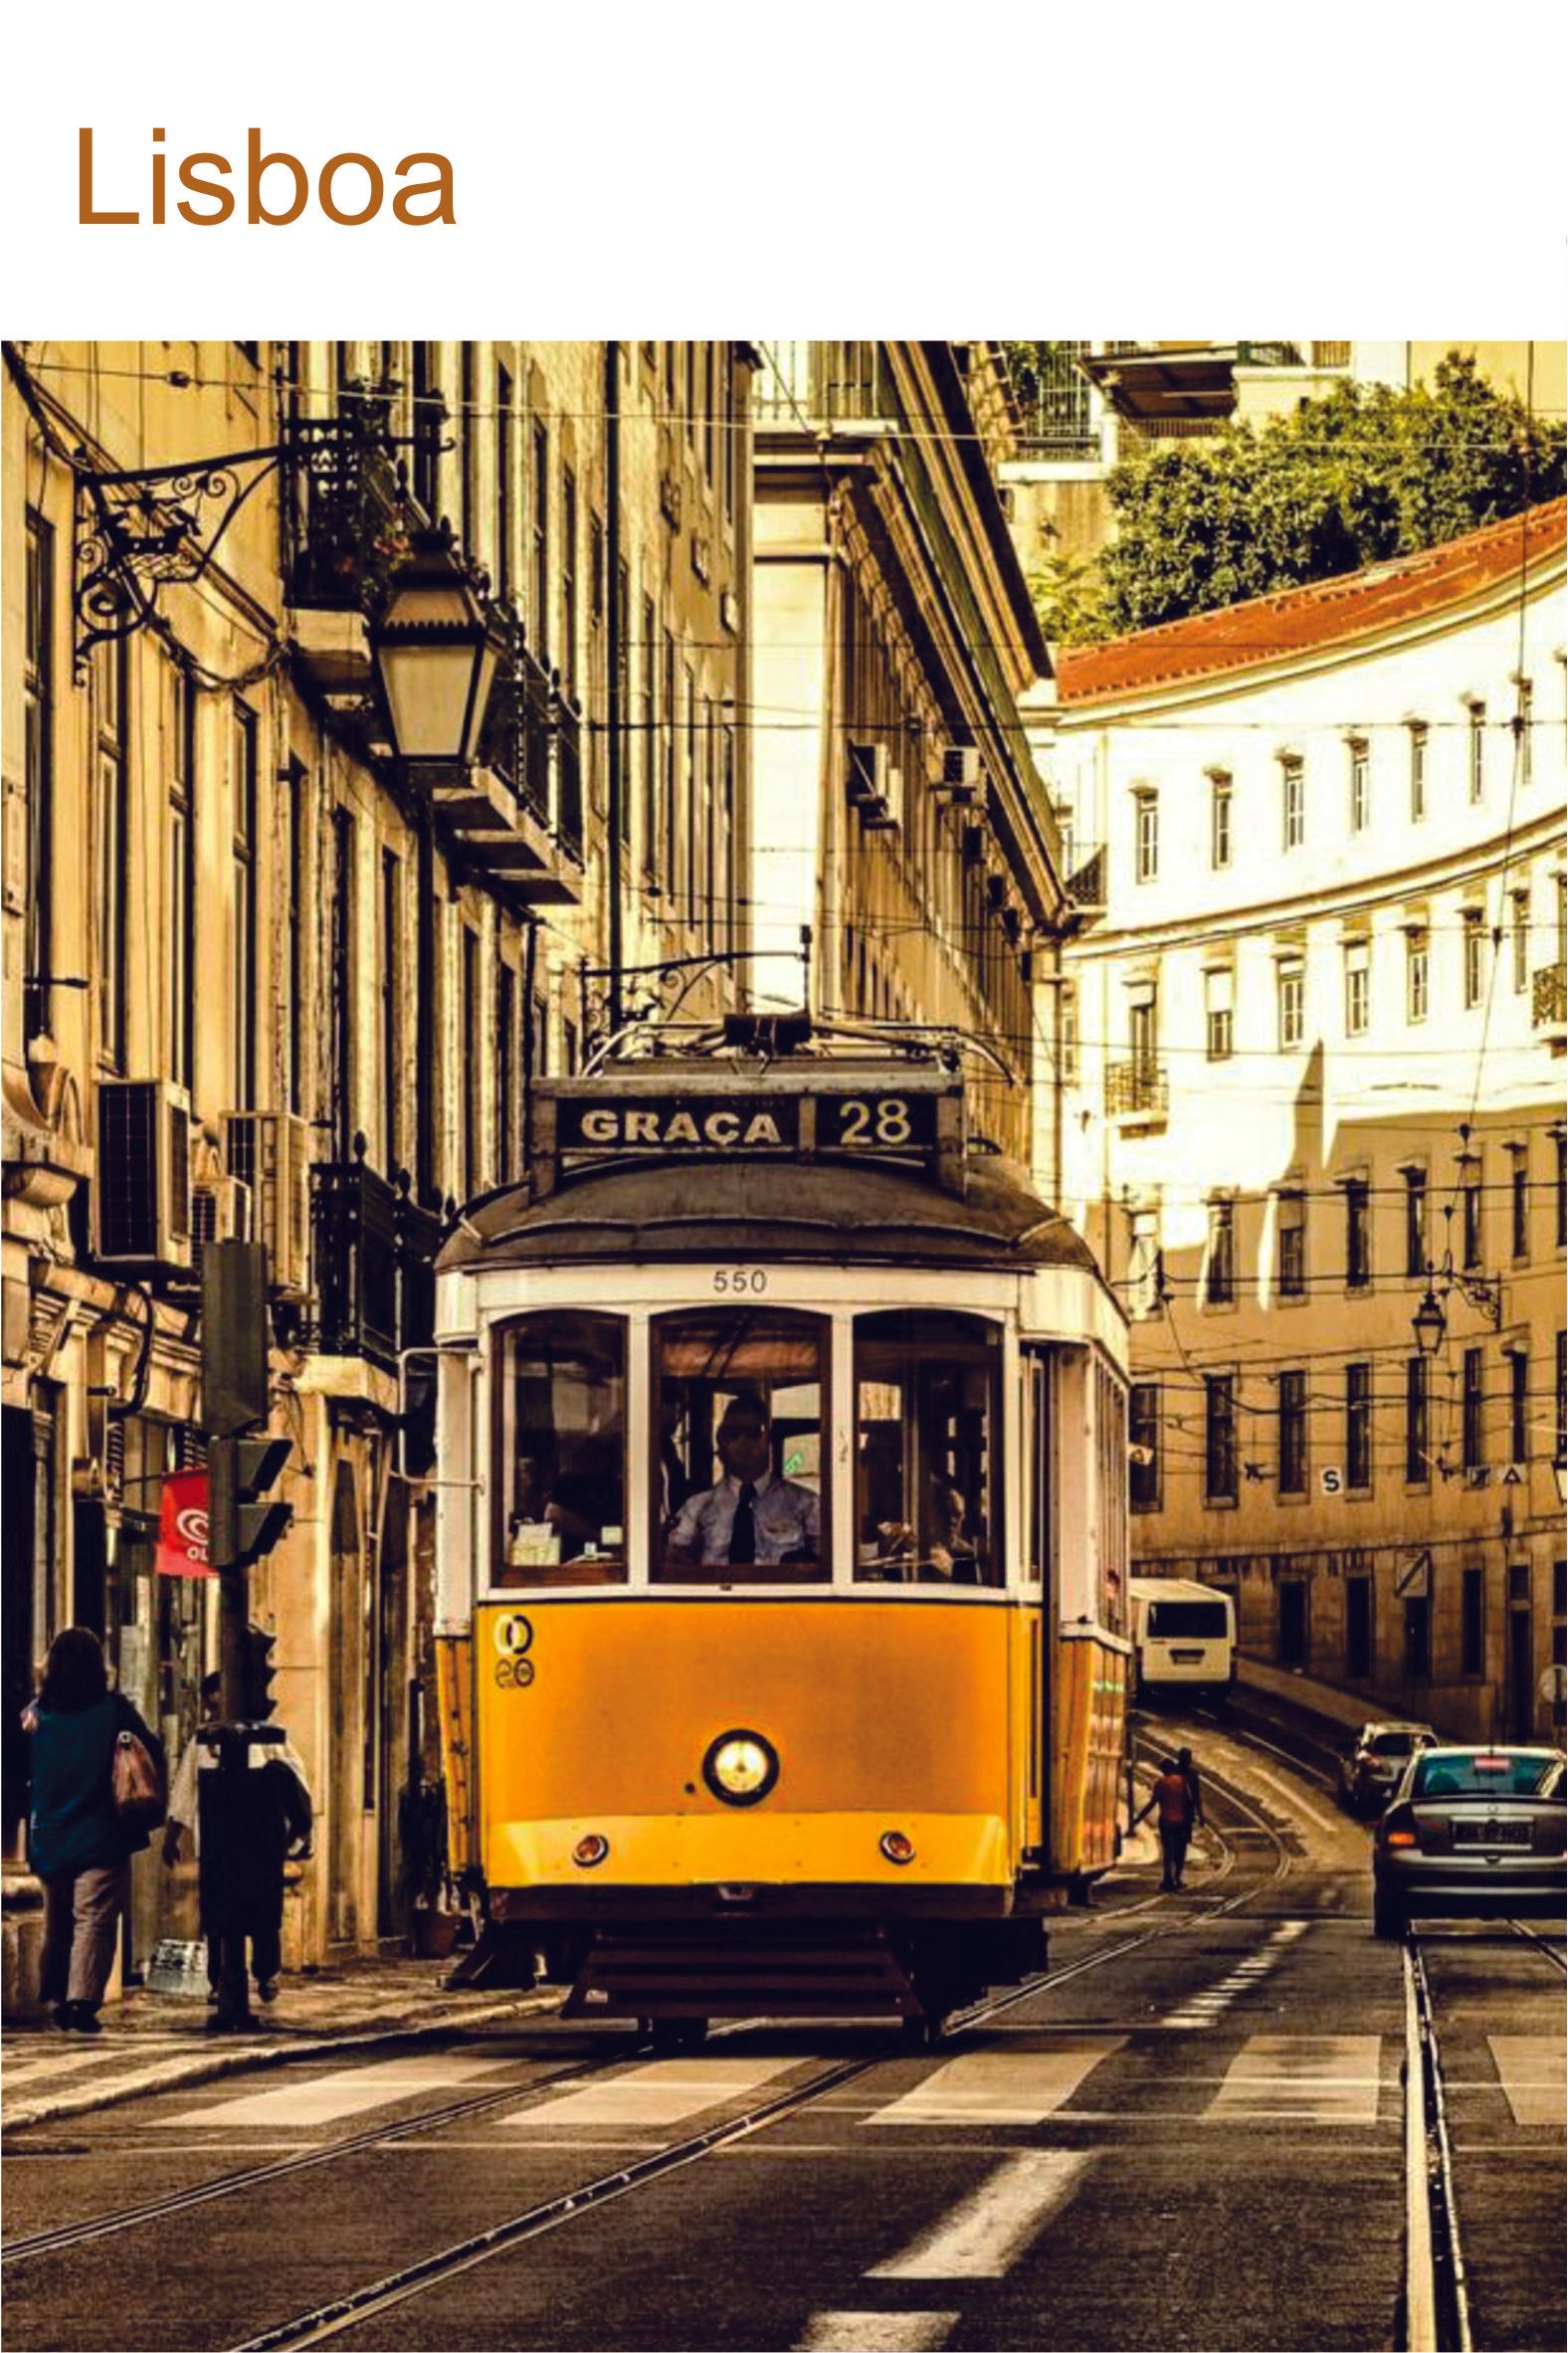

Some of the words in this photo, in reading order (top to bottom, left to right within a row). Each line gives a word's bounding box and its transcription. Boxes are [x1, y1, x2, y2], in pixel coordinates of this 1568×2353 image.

[581, 1109, 782, 1147] GRAÇA
[840, 1099, 911, 1144] 28
[713, 1270, 767, 1293] 550
[1322, 1470, 1340, 1492] S
[186, 1545, 209, 1562] OL
